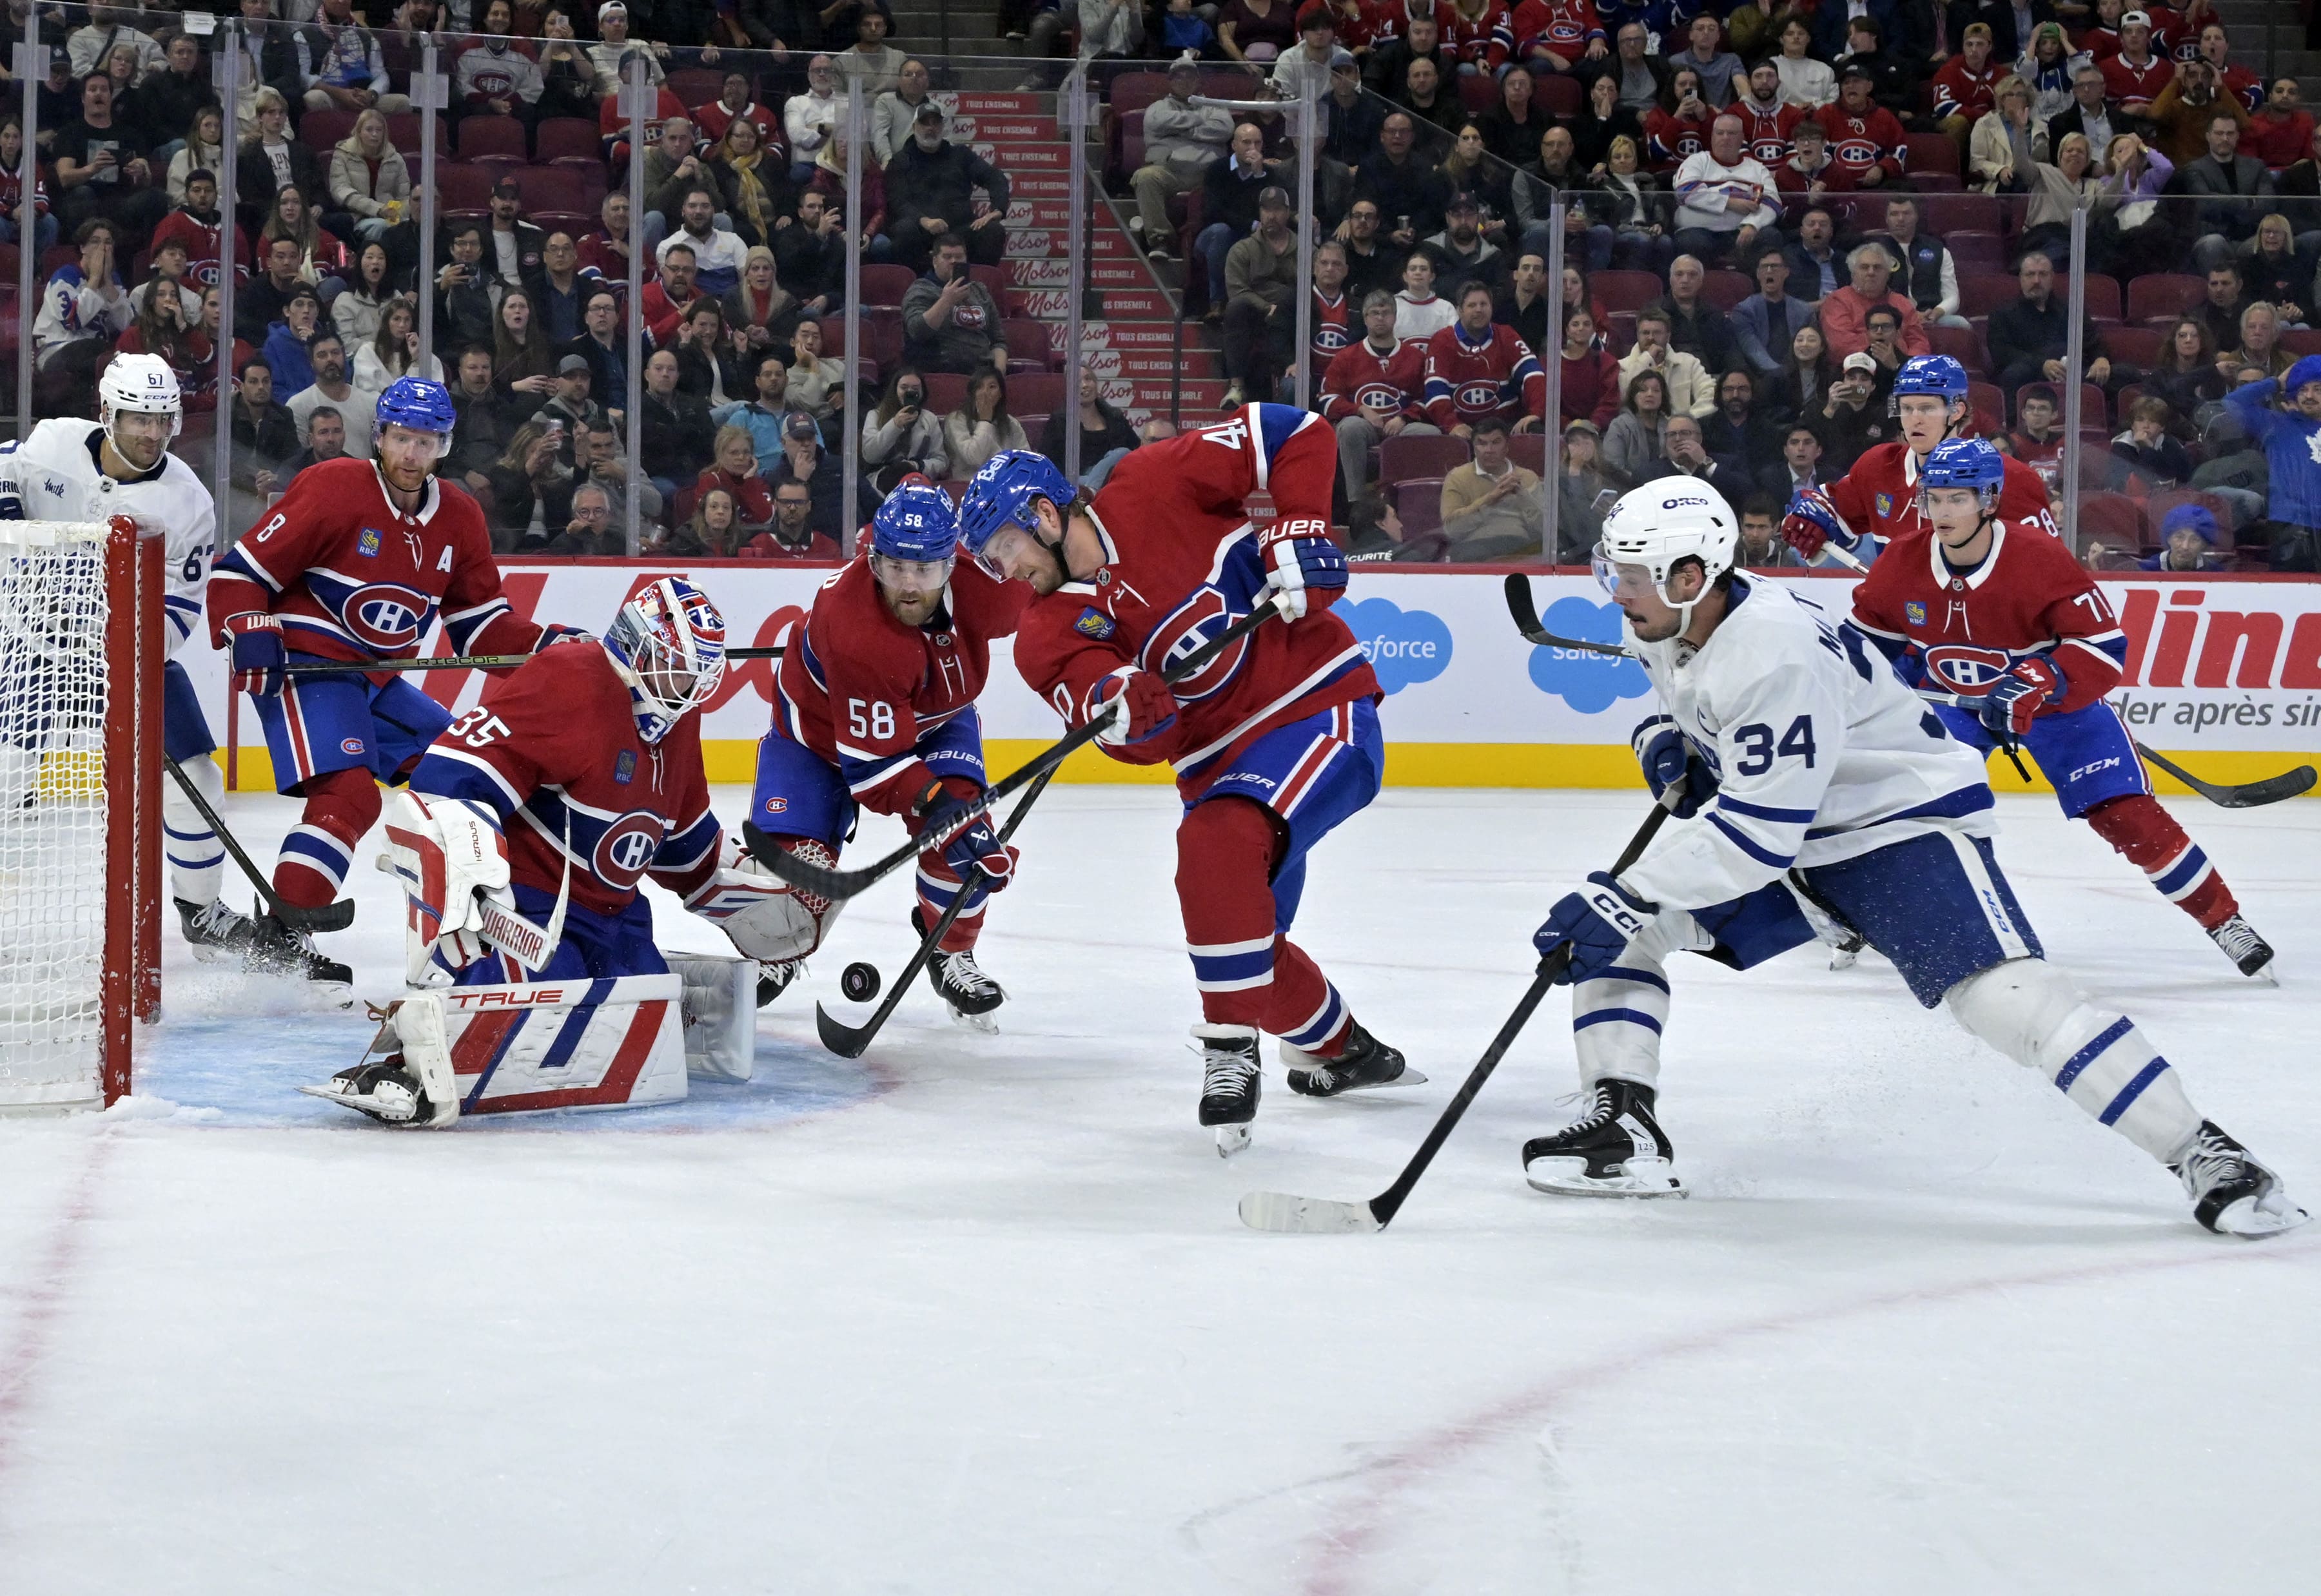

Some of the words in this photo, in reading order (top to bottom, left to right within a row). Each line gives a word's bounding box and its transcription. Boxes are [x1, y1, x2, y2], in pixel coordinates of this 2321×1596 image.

[966, 101, 983, 109] TOUS
[983, 126, 1001, 135] TOUS
[1020, 182, 1038, 190] TOUS
[1039, 182, 1070, 190] ENSEMBL
[1116, 333, 1135, 342] TOUS
[1128, 361, 1148, 370] TOUS
[147, 373, 163, 386] 67
[1141, 391, 1160, 400] TOUS
[976, 454, 1010, 482] Bell
[256, 512, 286, 543] 8
[904, 513, 923, 528] 58
[359, 545, 377, 556] RBC
[436, 545, 454, 573] A
[2073, 588, 2114, 623] 71
[1097, 623, 1113, 640] RBC
[416, 656, 500, 667] RIBCOR
[848, 697, 896, 740] 58
[2173, 694, 2274, 734] après
[447, 705, 512, 748] 35
[1734, 714, 1817, 777] 34
[2068, 756, 2120, 783] CCM
[616, 773, 631, 783] RBC
[483, 906, 544, 964] WARRIOR
[448, 989, 563, 1008] TRUE
[1638, 1143, 1655, 1151] 125
